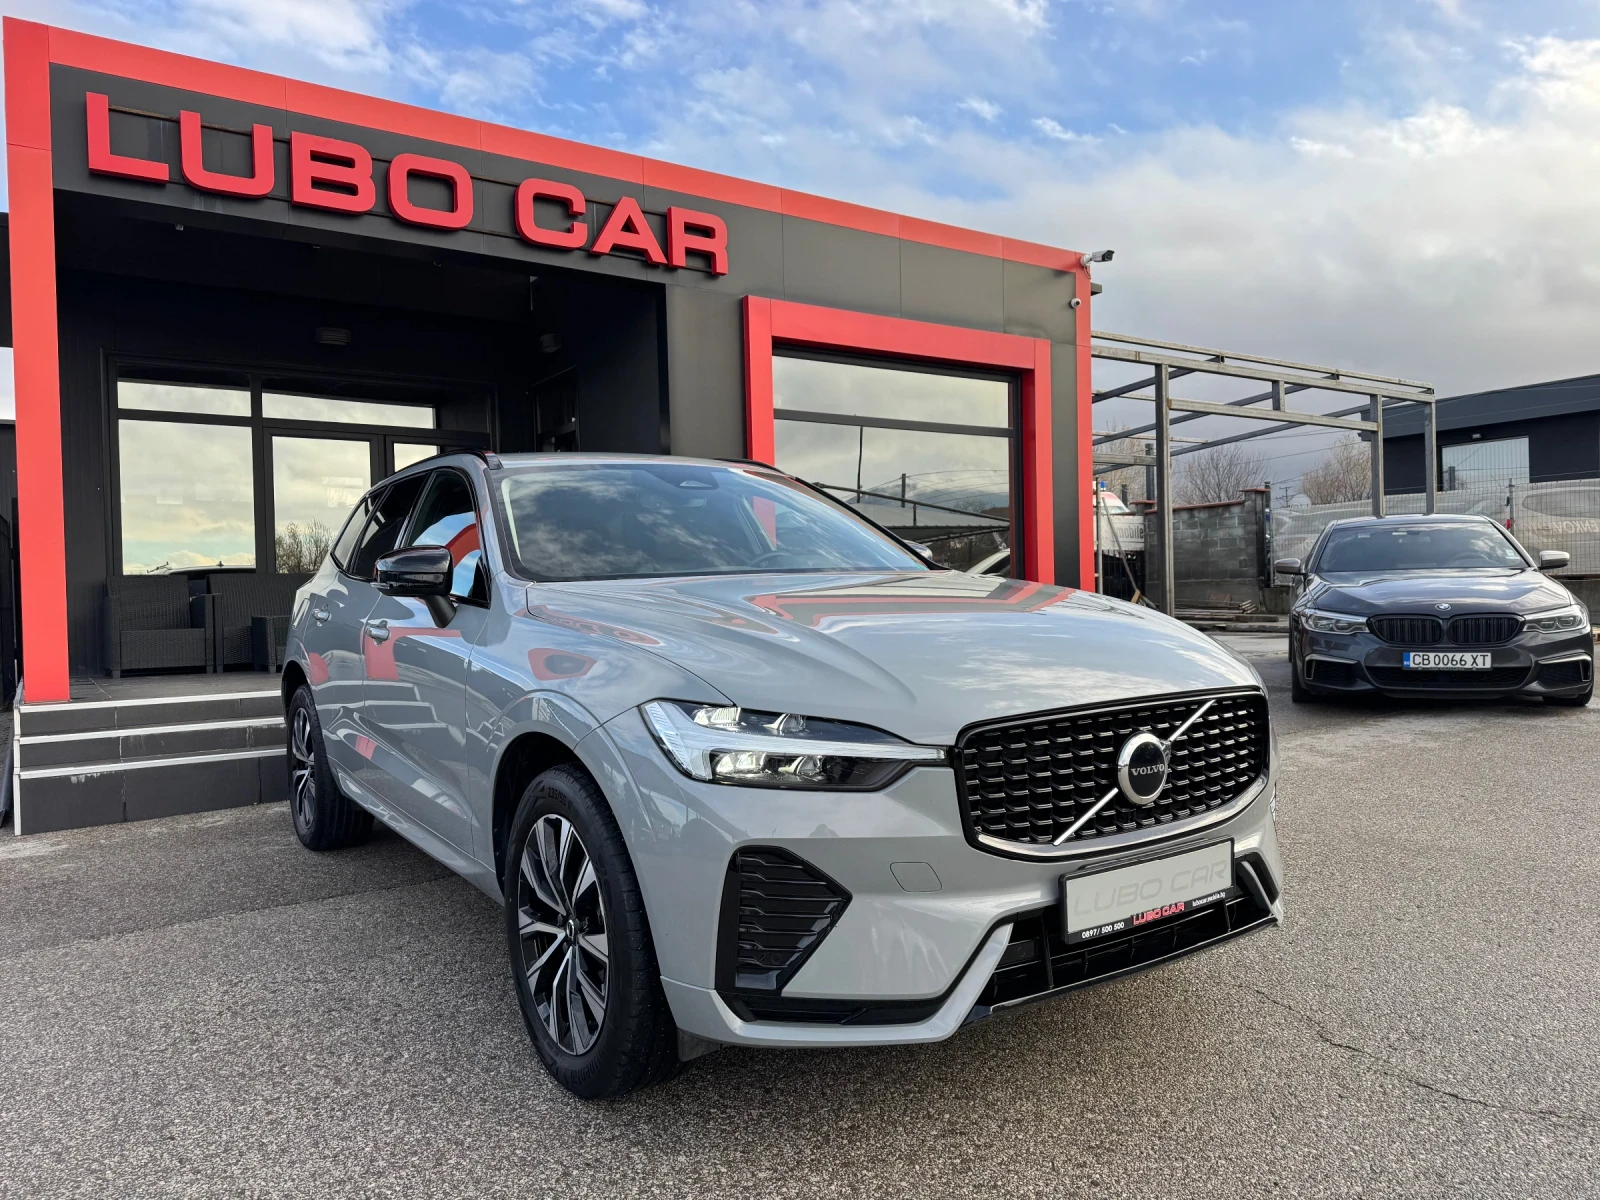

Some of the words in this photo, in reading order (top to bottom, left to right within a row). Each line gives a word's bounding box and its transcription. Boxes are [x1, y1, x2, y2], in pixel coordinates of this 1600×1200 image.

[87, 92, 473, 229] LUBO
[514, 178, 728, 276] CAR
[1412, 653, 1431, 666] CB
[1433, 654, 1467, 666] 0066
[1471, 654, 1489, 667] XT
[1130, 763, 1165, 776] VOLVO
[1074, 880, 1163, 915] LUBO
[1170, 860, 1228, 893] CAR
[1101, 925, 1113, 934] 500
[1114, 921, 1125, 930] 500
[1133, 909, 1161, 925] LUBO
[1162, 902, 1185, 916] CAR
